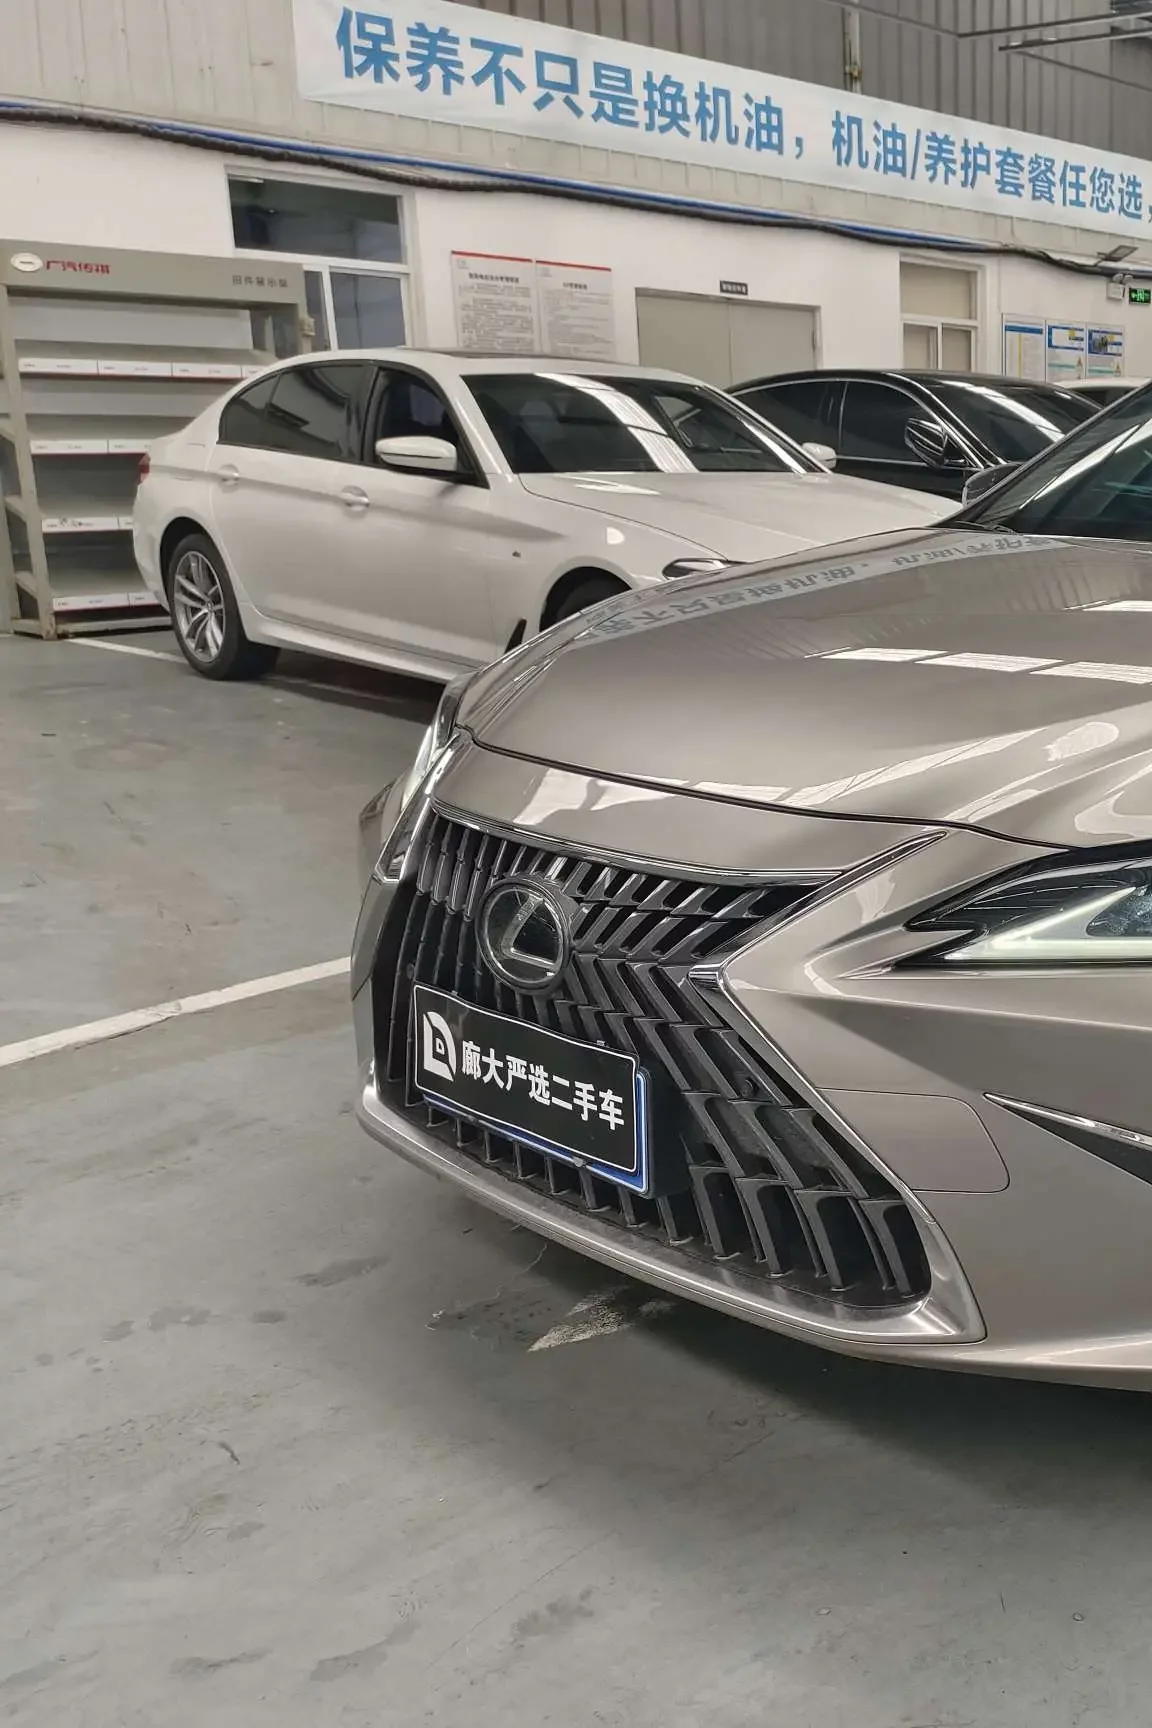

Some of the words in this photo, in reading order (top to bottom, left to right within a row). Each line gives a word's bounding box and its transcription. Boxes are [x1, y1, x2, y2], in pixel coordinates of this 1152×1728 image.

[462, 1040, 625, 1131] 廊大严选二手车
